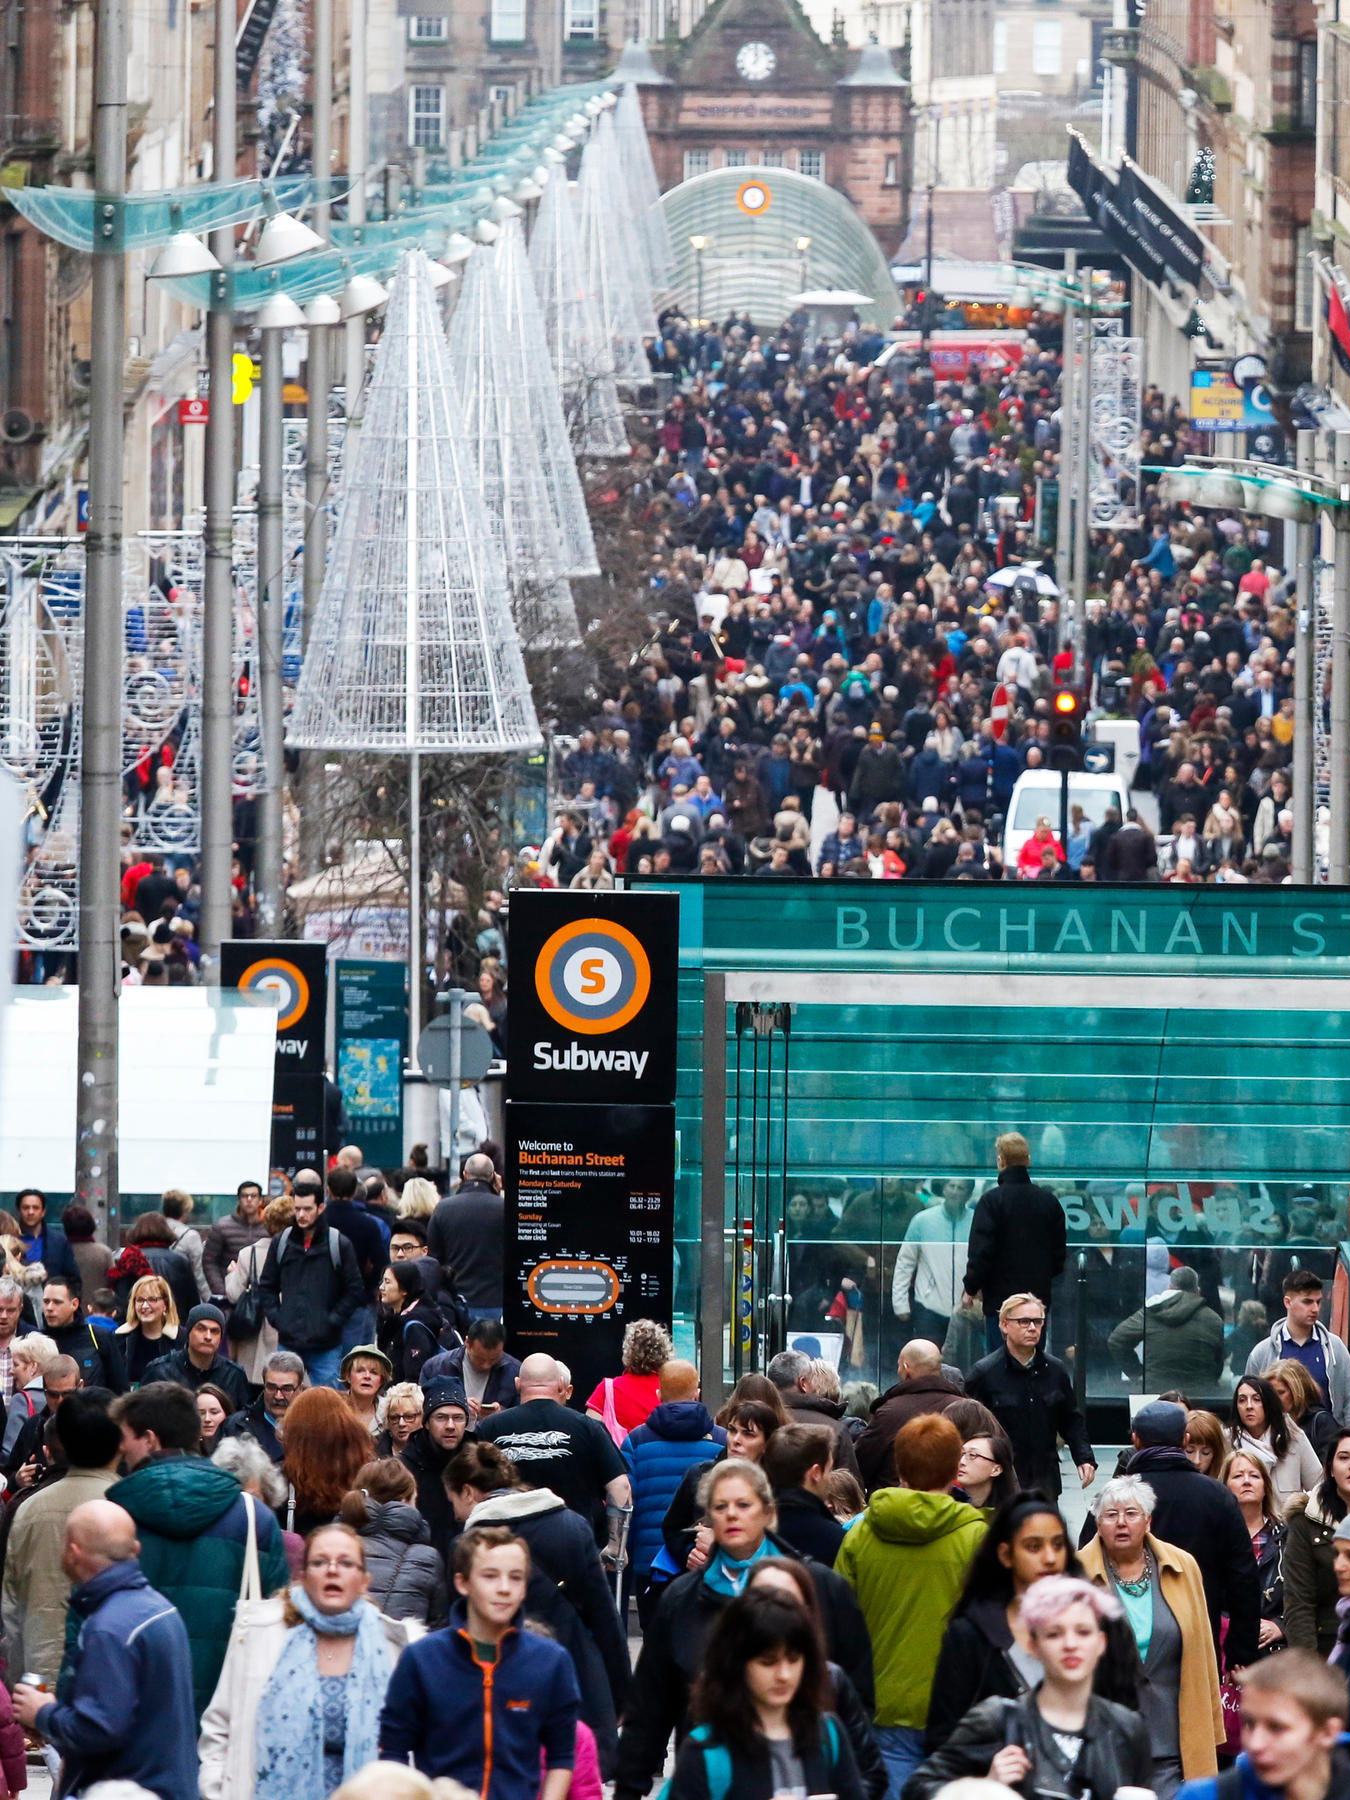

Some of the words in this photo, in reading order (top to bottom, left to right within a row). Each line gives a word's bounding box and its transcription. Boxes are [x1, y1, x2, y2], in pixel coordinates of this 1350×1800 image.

[835, 906, 1258, 955] BUCHANAN
[581, 959, 605, 994] S
[533, 1041, 649, 1079] Subway
[518, 1140, 562, 1151] Welcome
[563, 1142, 573, 1151] to
[519, 1152, 583, 1165] Buchanan
[586, 1153, 624, 1166] Street
[519, 1180, 544, 1188] Monday
[553, 1180, 581, 1189] Saturday
[518, 1213, 542, 1221] Sunday
